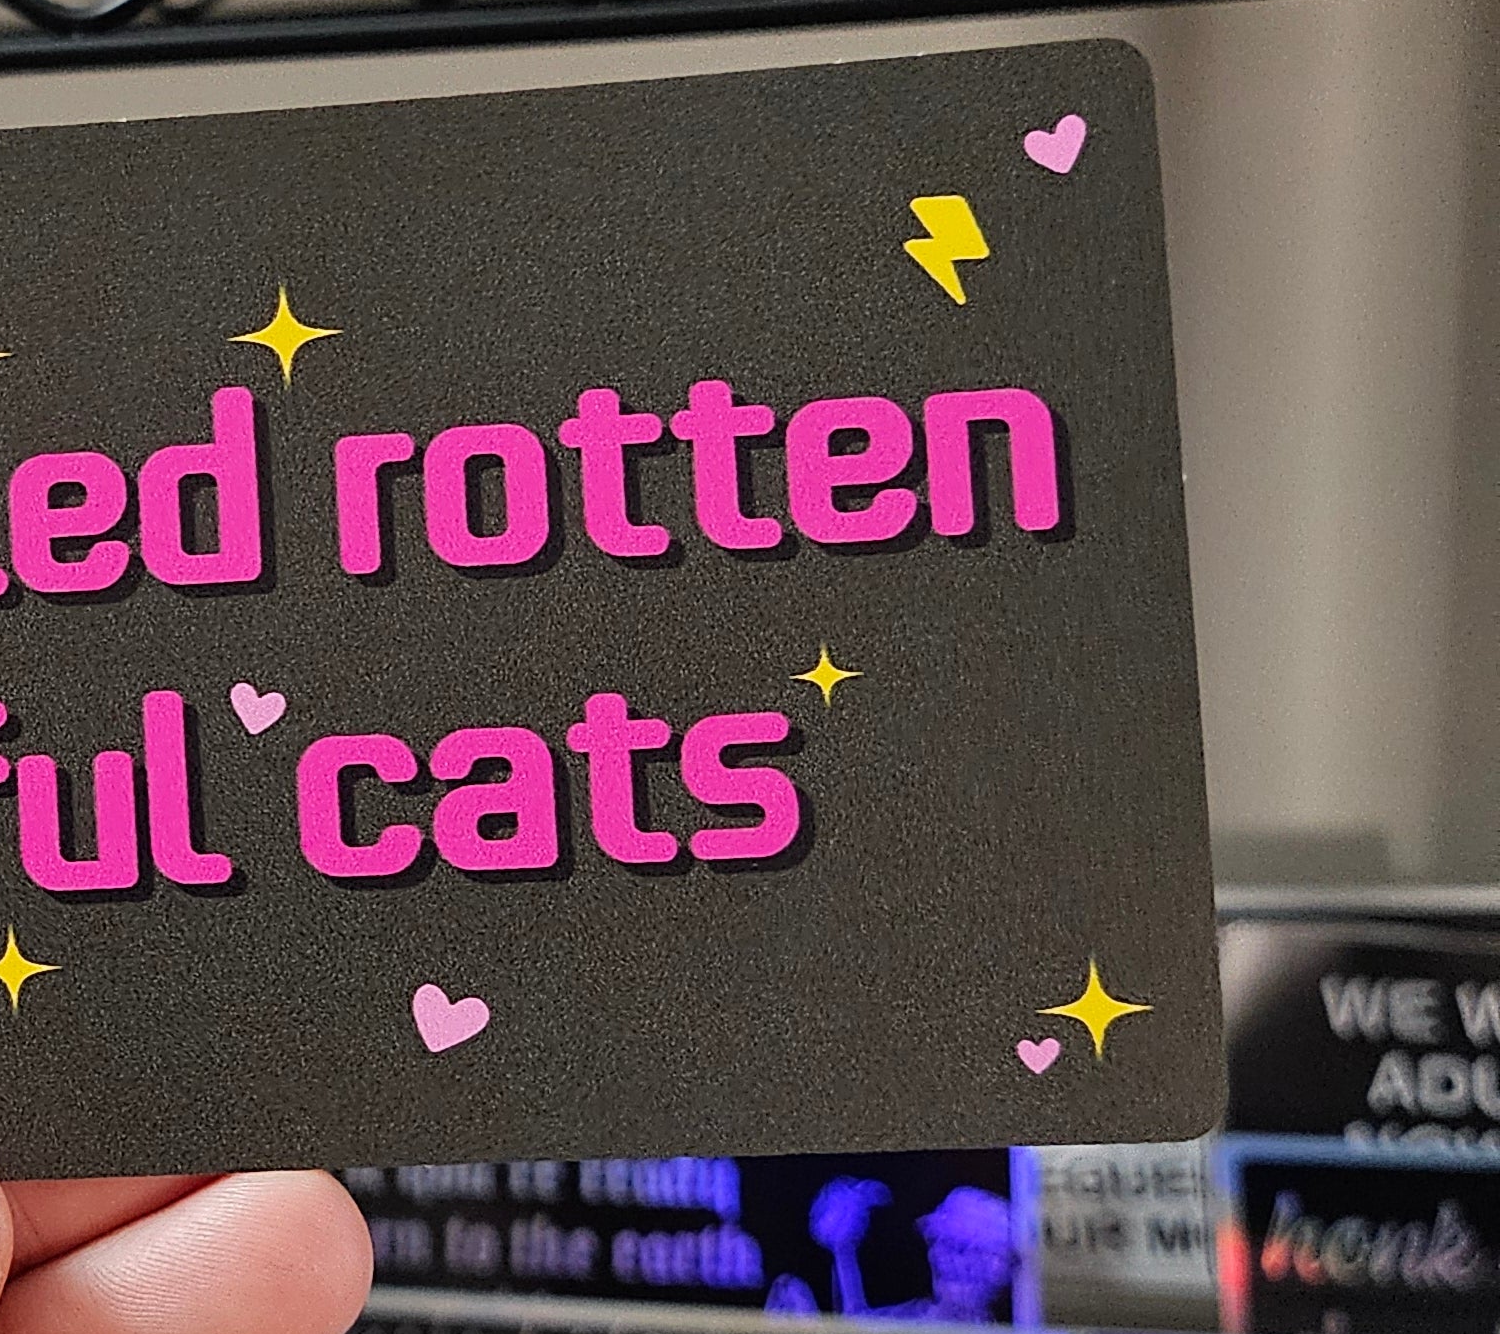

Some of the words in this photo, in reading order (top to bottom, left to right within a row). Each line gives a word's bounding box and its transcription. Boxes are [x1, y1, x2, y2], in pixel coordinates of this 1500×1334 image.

[333, 378, 1066, 579] rotten
[294, 690, 808, 881] cats
[1319, 971, 1449, 1045] WE
